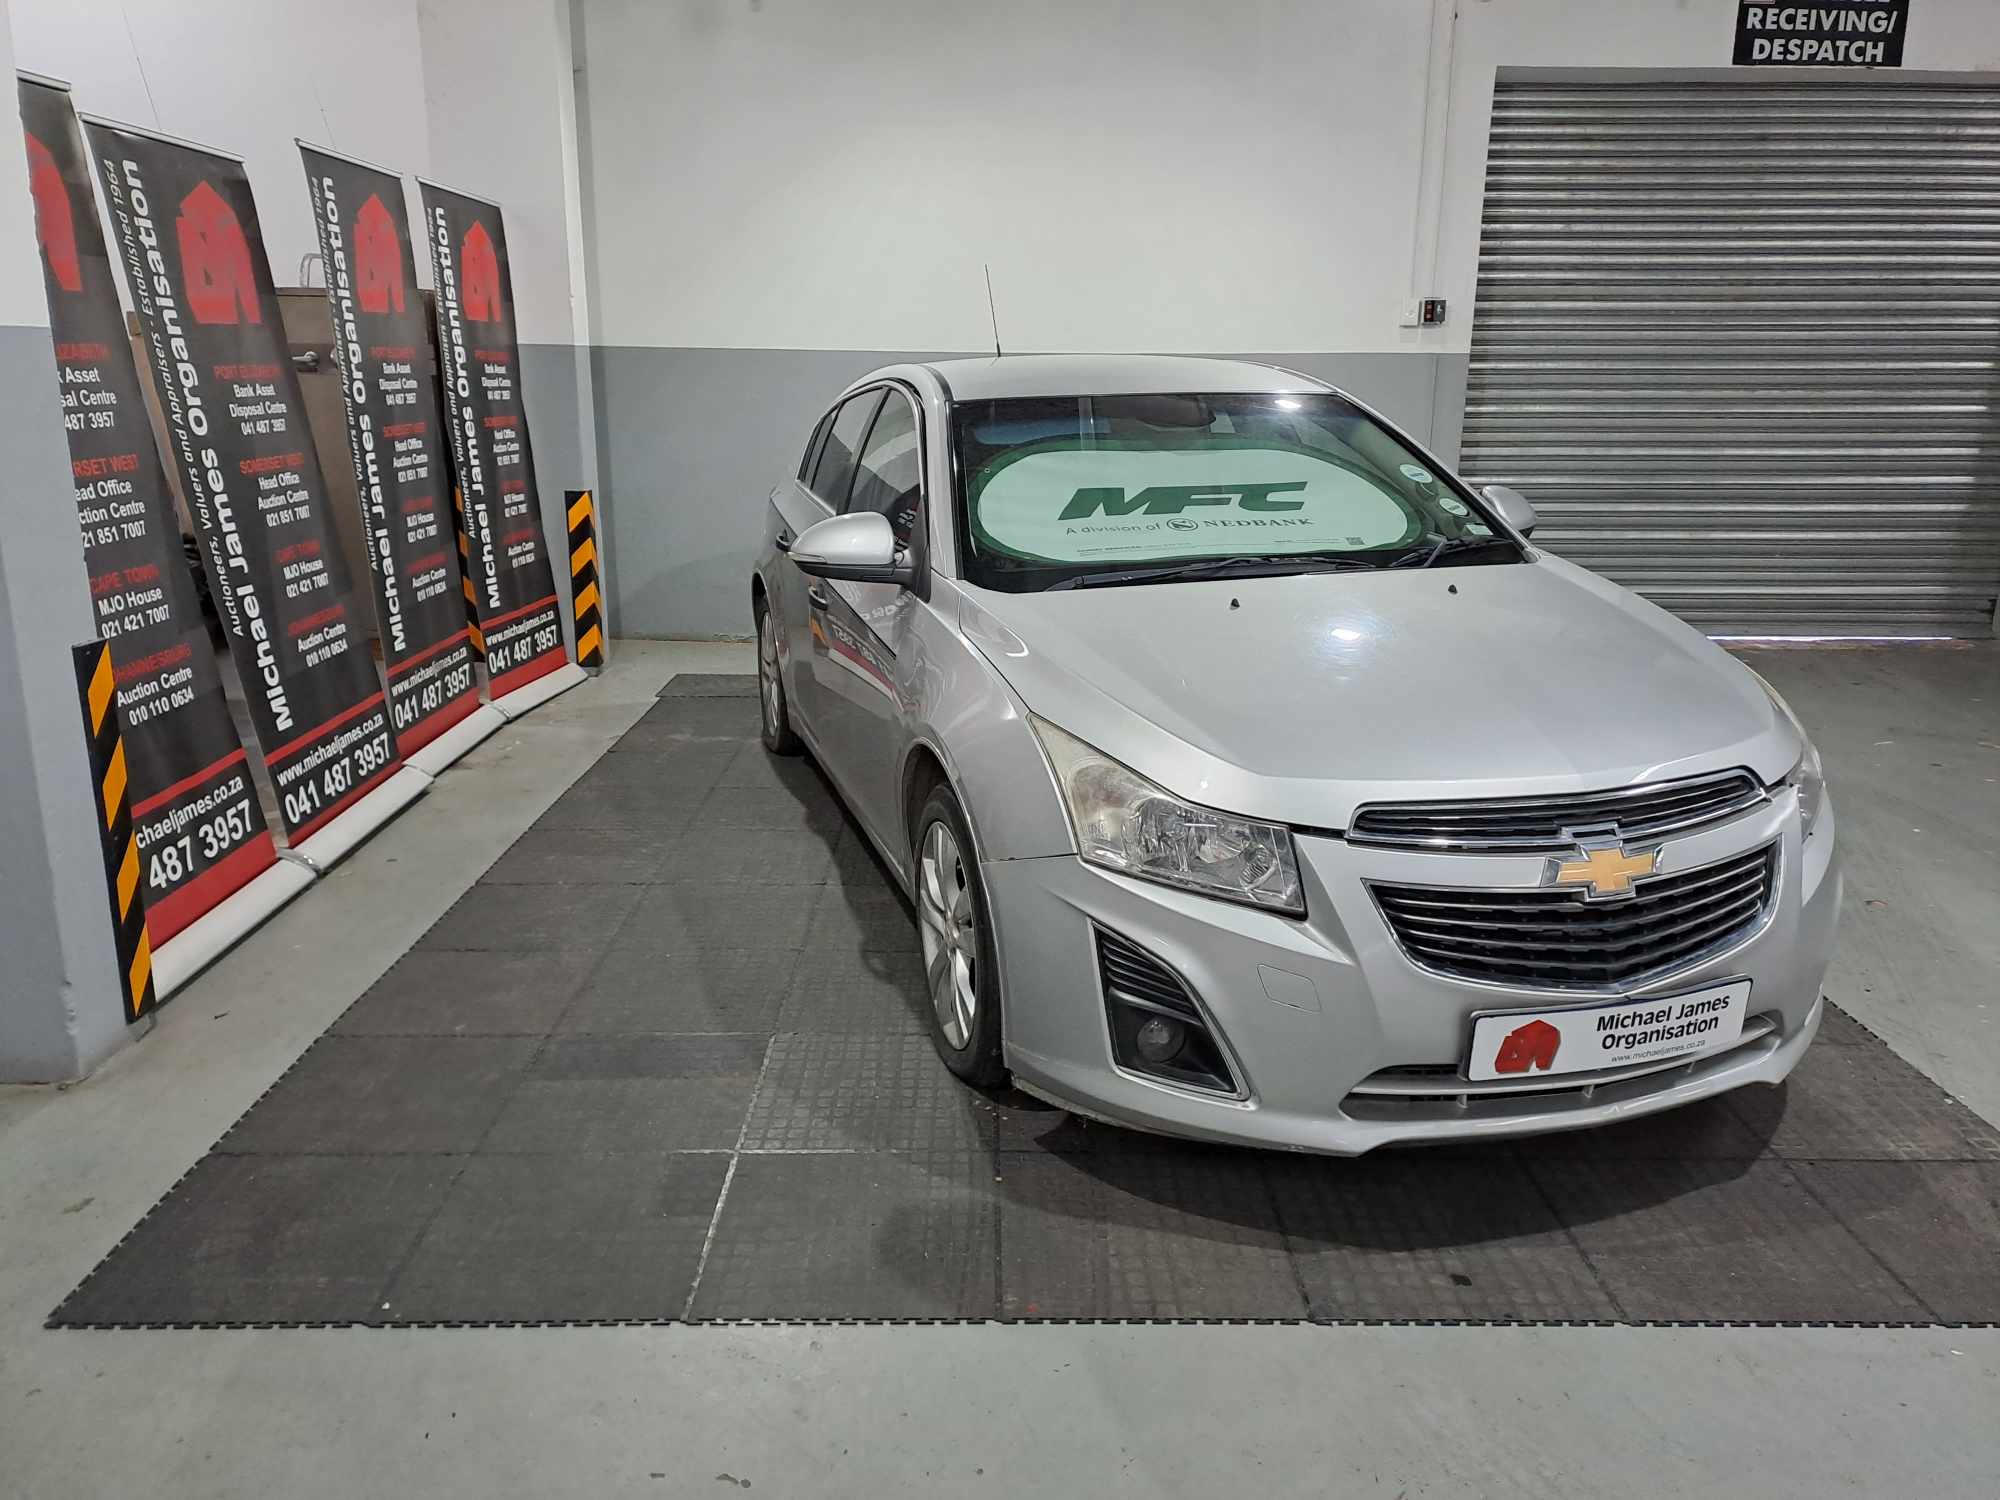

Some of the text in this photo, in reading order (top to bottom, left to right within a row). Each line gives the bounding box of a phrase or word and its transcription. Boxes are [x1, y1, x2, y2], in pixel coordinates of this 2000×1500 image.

[1746, 7, 1898, 34] RECEIVING/
[1752, 38, 1885, 63] DESPATCH
[65, 367, 101, 383] Asset
[80, 389, 117, 406] Centre
[103, 159, 244, 637] Auctioneers, Valuers and Appraisers Established 1964
[229, 402, 265, 419] Disposal
[322, 177, 406, 652] Michael James Organisation
[435, 207, 501, 609] Michael James Organisation
[65, 411, 115, 430] 487 3957
[122, 159, 294, 732] Michael James Organisation
[97, 479, 132, 497] Office
[257, 494, 287, 511] Auction
[1057, 481, 1308, 521] MFC
[109, 500, 145, 518] Centre
[97, 526, 119, 545] 851
[120, 520, 147, 539] 7007
[1066, 517, 1315, 536] A division of NEDBANK
[98, 587, 163, 617] MJO House
[101, 604, 170, 639] 021 421 7007
[488, 624, 557, 674] 041 487 3957
[116, 665, 193, 707] Auction Centre
[395, 663, 470, 729] 041 487 3957
[129, 686, 194, 727] 010 110 0634
[277, 713, 384, 787] www.michaeljames.co.za
[285, 732, 391, 824] 041 487 3957
[149, 799, 252, 889] 487 3957
[1597, 995, 1731, 1032] Michael James
[1602, 1016, 1719, 1050] Organisation
[1611, 1039, 1705, 1062] www.michaeljames.co.za
